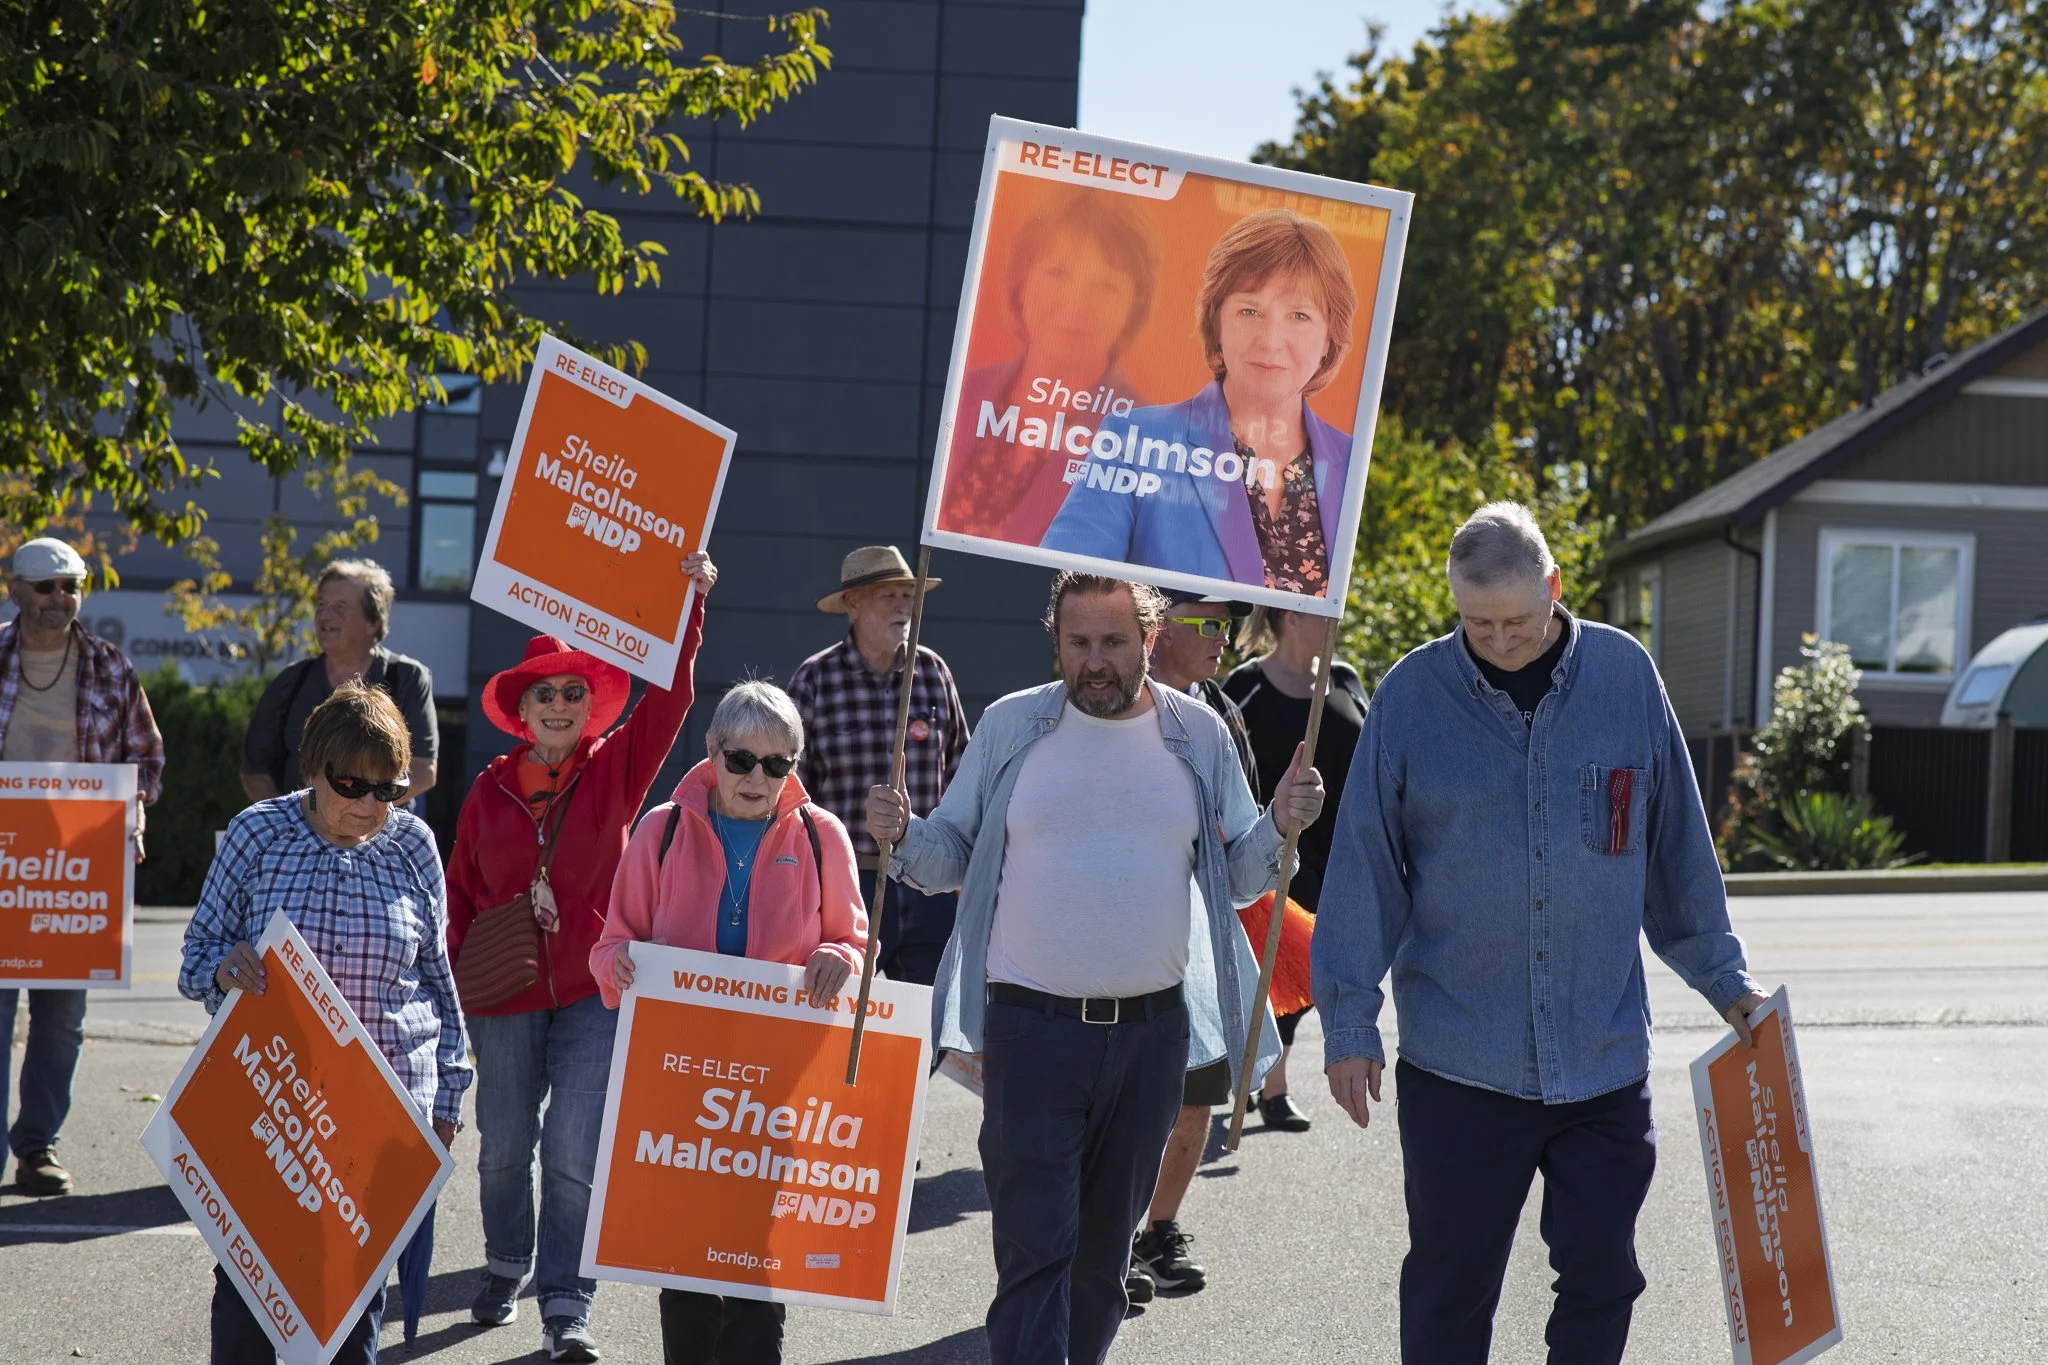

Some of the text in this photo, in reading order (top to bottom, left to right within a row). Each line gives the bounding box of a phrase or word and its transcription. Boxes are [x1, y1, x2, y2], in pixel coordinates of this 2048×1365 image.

[1019, 141, 1169, 188] RE-ELECT
[556, 354, 628, 400] RE-ELECT
[1027, 377, 1134, 419] Sheila
[560, 434, 638, 489] Sheila
[975, 400, 1276, 490] Malcolmson
[535, 452, 685, 548] Malcolmson
[1086, 464, 1162, 497] NDP
[583, 511, 641, 554] NDP
[507, 582, 649, 658] ACTION FOR YOU
[28, 778, 62, 789] FOR
[67, 778, 103, 790] YOU
[50, 914, 108, 934] NDP
[280, 939, 348, 1034] RE-ELECT
[673, 971, 788, 1003] WORKING
[264, 1035, 337, 1141] Sheila
[663, 1053, 770, 1085] RE-ELECT
[1781, 1016, 1806, 1138] RE-ELECT
[232, 1033, 371, 1247] Malcolmson
[695, 1088, 863, 1149] Sheila
[1762, 1086, 1789, 1212] Sheila
[264, 1140, 323, 1213] NDP
[634, 1130, 880, 1195] Malcolmson
[1745, 1060, 1793, 1328] Malcolmson
[797, 1194, 876, 1229] NDP
[1703, 1108, 1745, 1344] ACTION FOR YOU
[1750, 1170, 1773, 1262] NDP
[173, 1152, 299, 1339] ACTION FOR YOU
[707, 1247, 781, 1270] bcndp.ca
